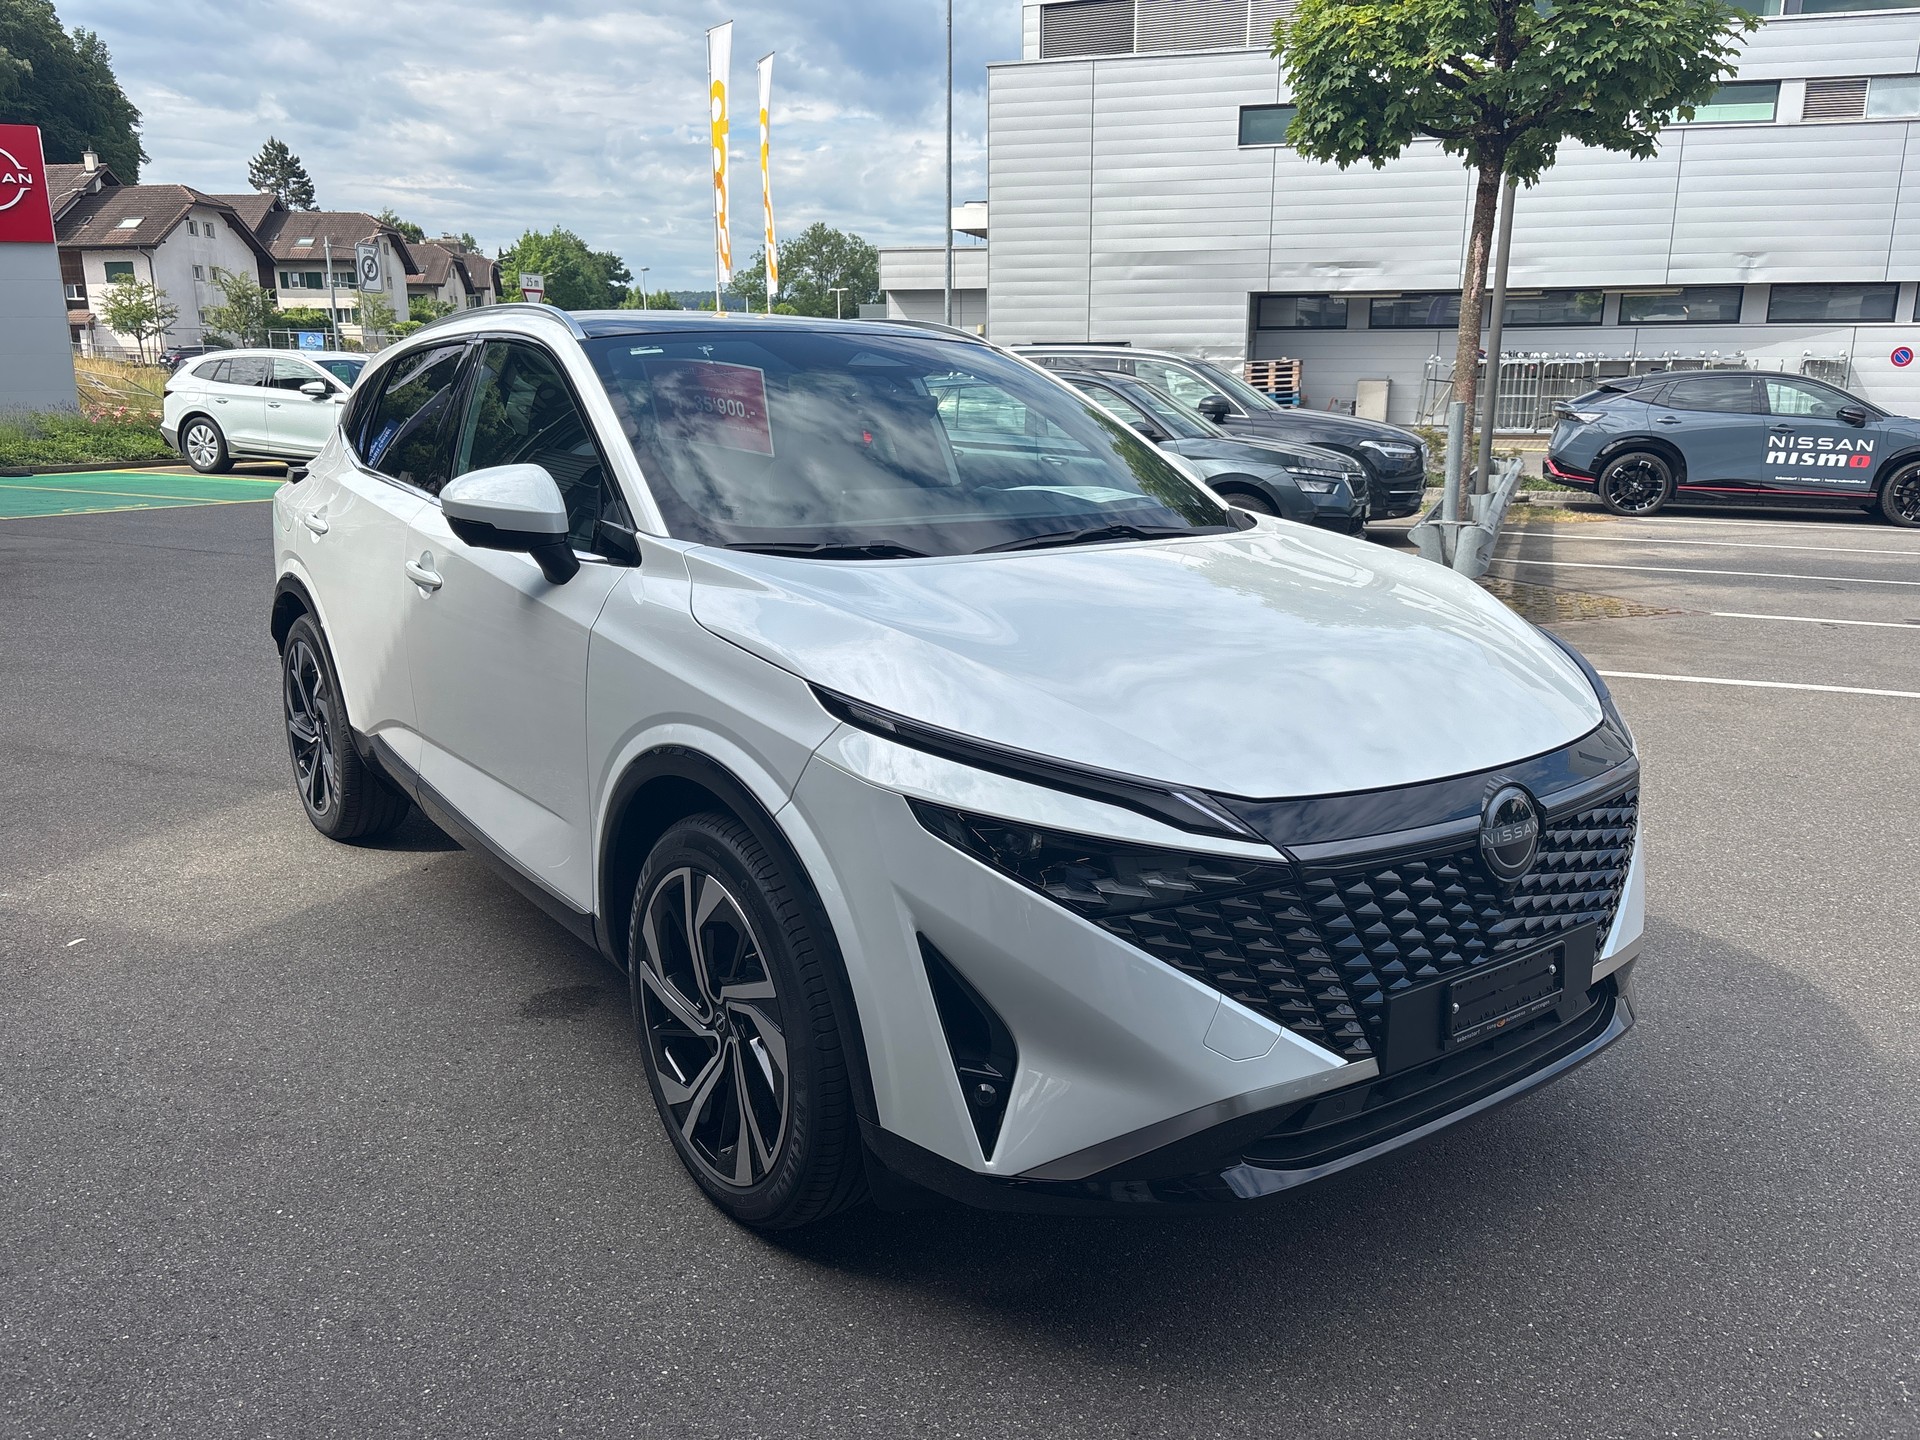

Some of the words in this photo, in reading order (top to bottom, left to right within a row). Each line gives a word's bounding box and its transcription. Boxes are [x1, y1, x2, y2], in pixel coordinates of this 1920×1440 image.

[366, 263, 375, 273] 30
[526, 276, 533, 287] 25
[1768, 435, 1874, 451] NISSAN
[1765, 451, 1871, 468] nismo
[1482, 820, 1539, 846] NISSAN
